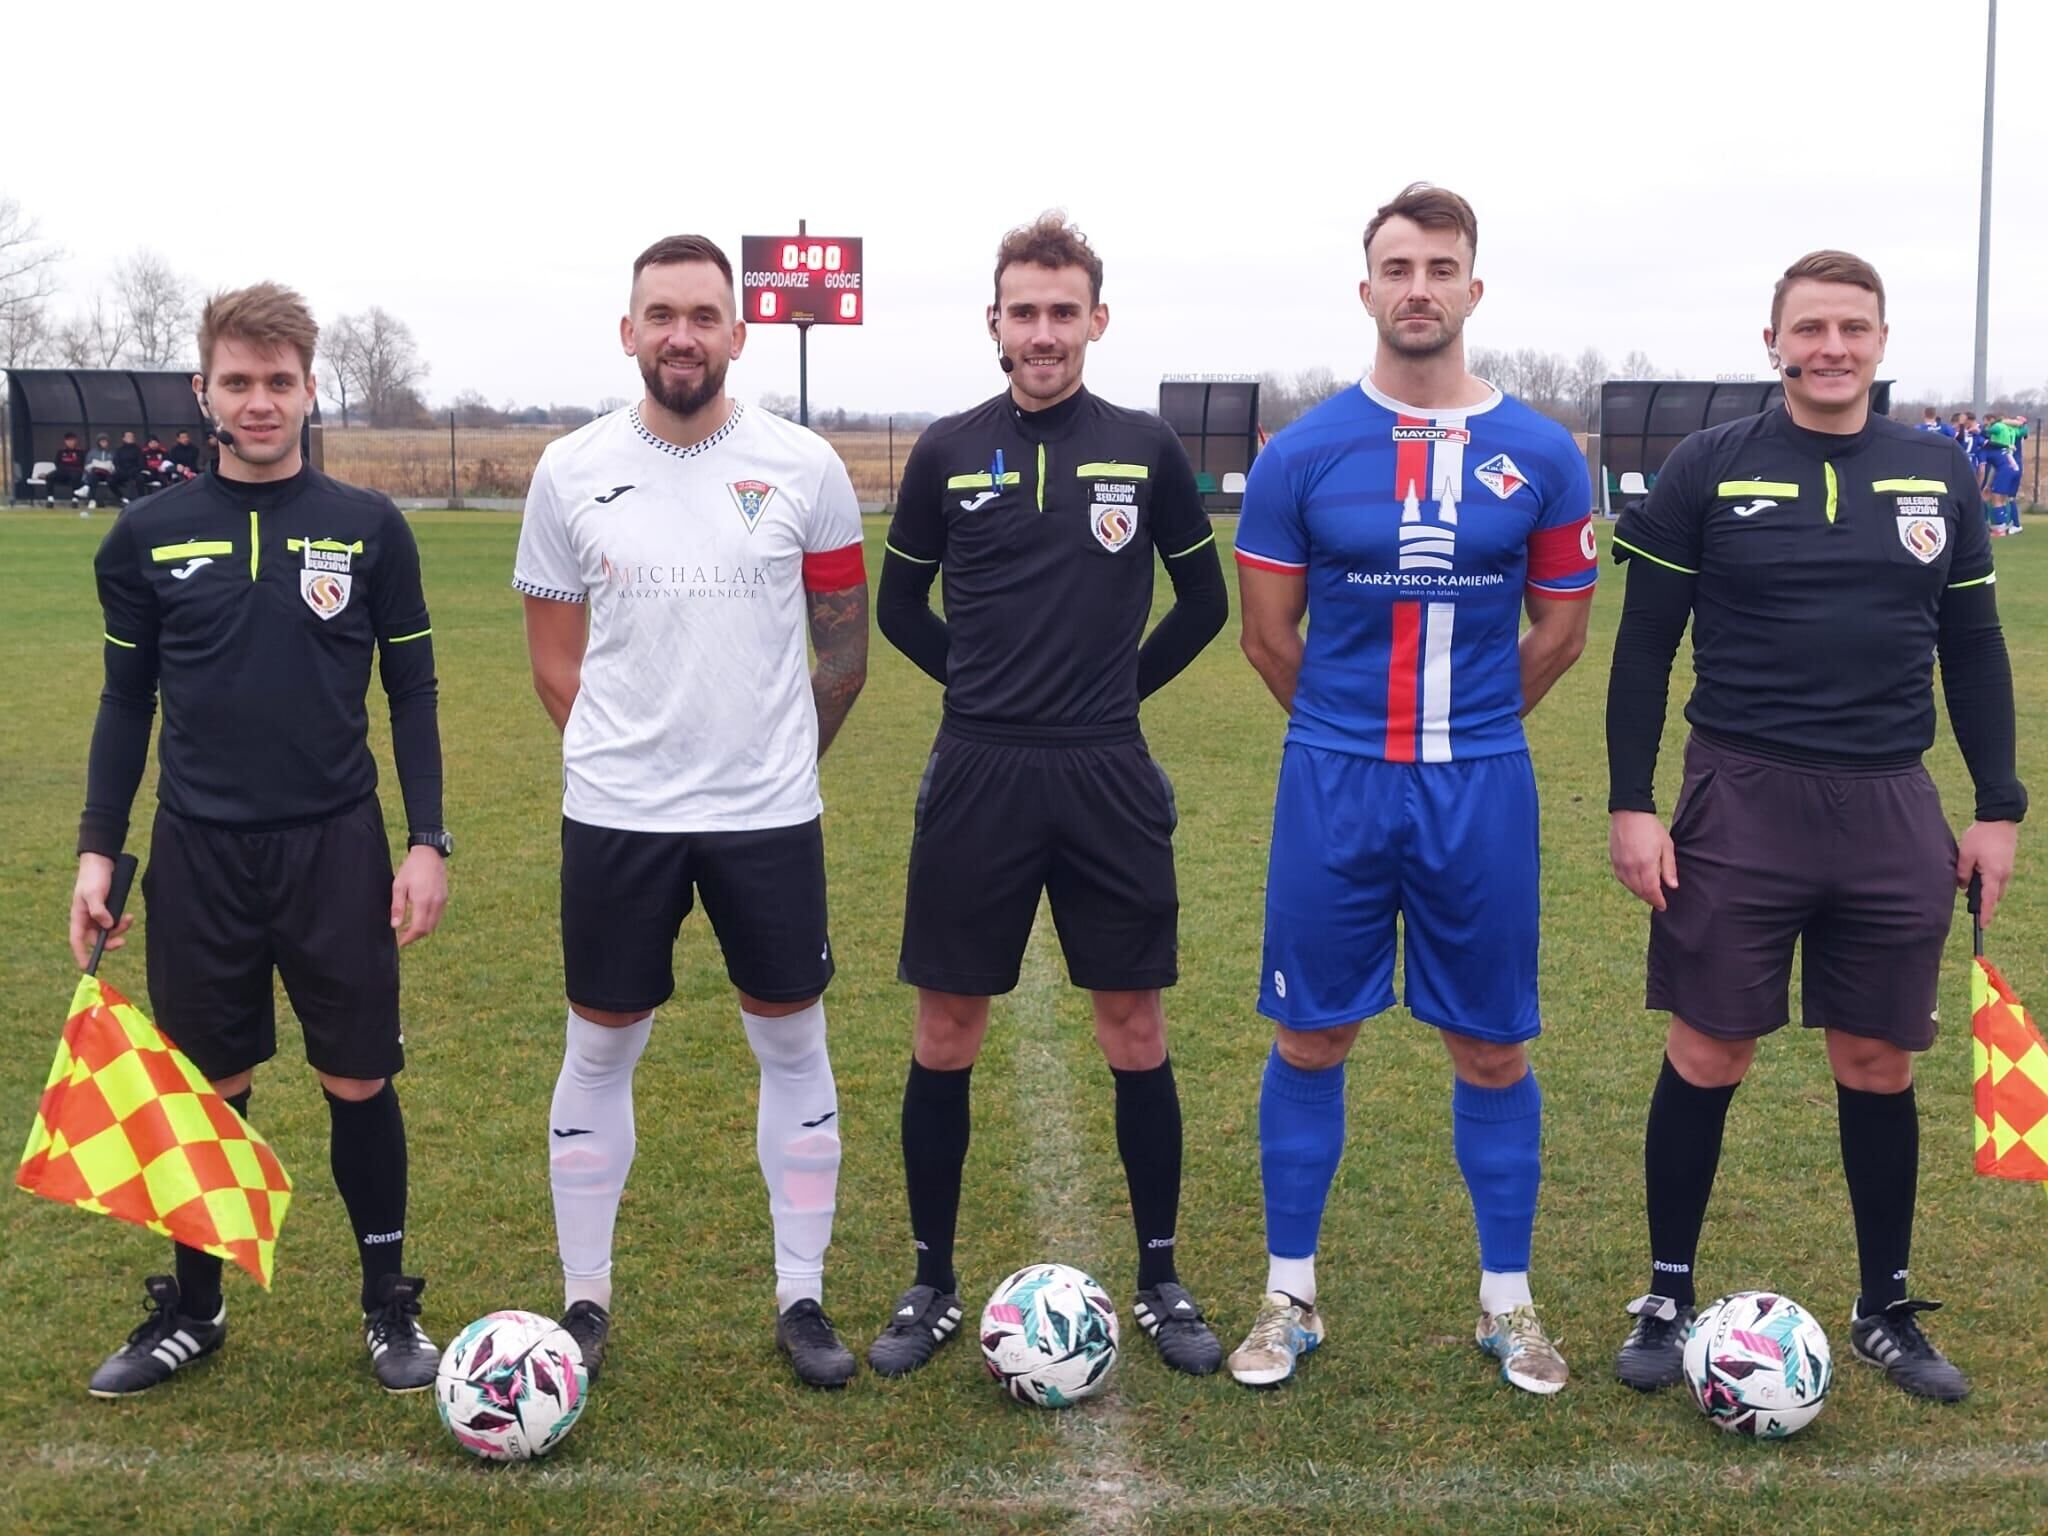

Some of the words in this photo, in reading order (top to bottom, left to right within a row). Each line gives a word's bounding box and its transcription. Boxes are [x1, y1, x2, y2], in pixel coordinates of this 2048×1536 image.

[782, 244, 841, 271] 0:00
[744, 271, 809, 287] GOSPODARZE
[825, 270, 860, 288] GOŚCIE
[760, 291, 776, 317] 0
[840, 292, 857, 318] 0
[1162, 373, 1198, 381] PUNKT
[1395, 430, 1447, 438] MAYOR
[1094, 483, 1136, 493] KOLEGIUM
[1580, 521, 1597, 560] C
[615, 566, 766, 584] MICHALAK
[1347, 572, 1503, 586] SKARŻYSKO-KAMIENNA
[618, 589, 680, 598] MASZYNY
[689, 588, 757, 599] ROLNICZE
[1274, 970, 1286, 998] 9
[364, 1230, 402, 1244] Joma
[1148, 1238, 1175, 1248] Jom
[1653, 1260, 1690, 1272] Joma
